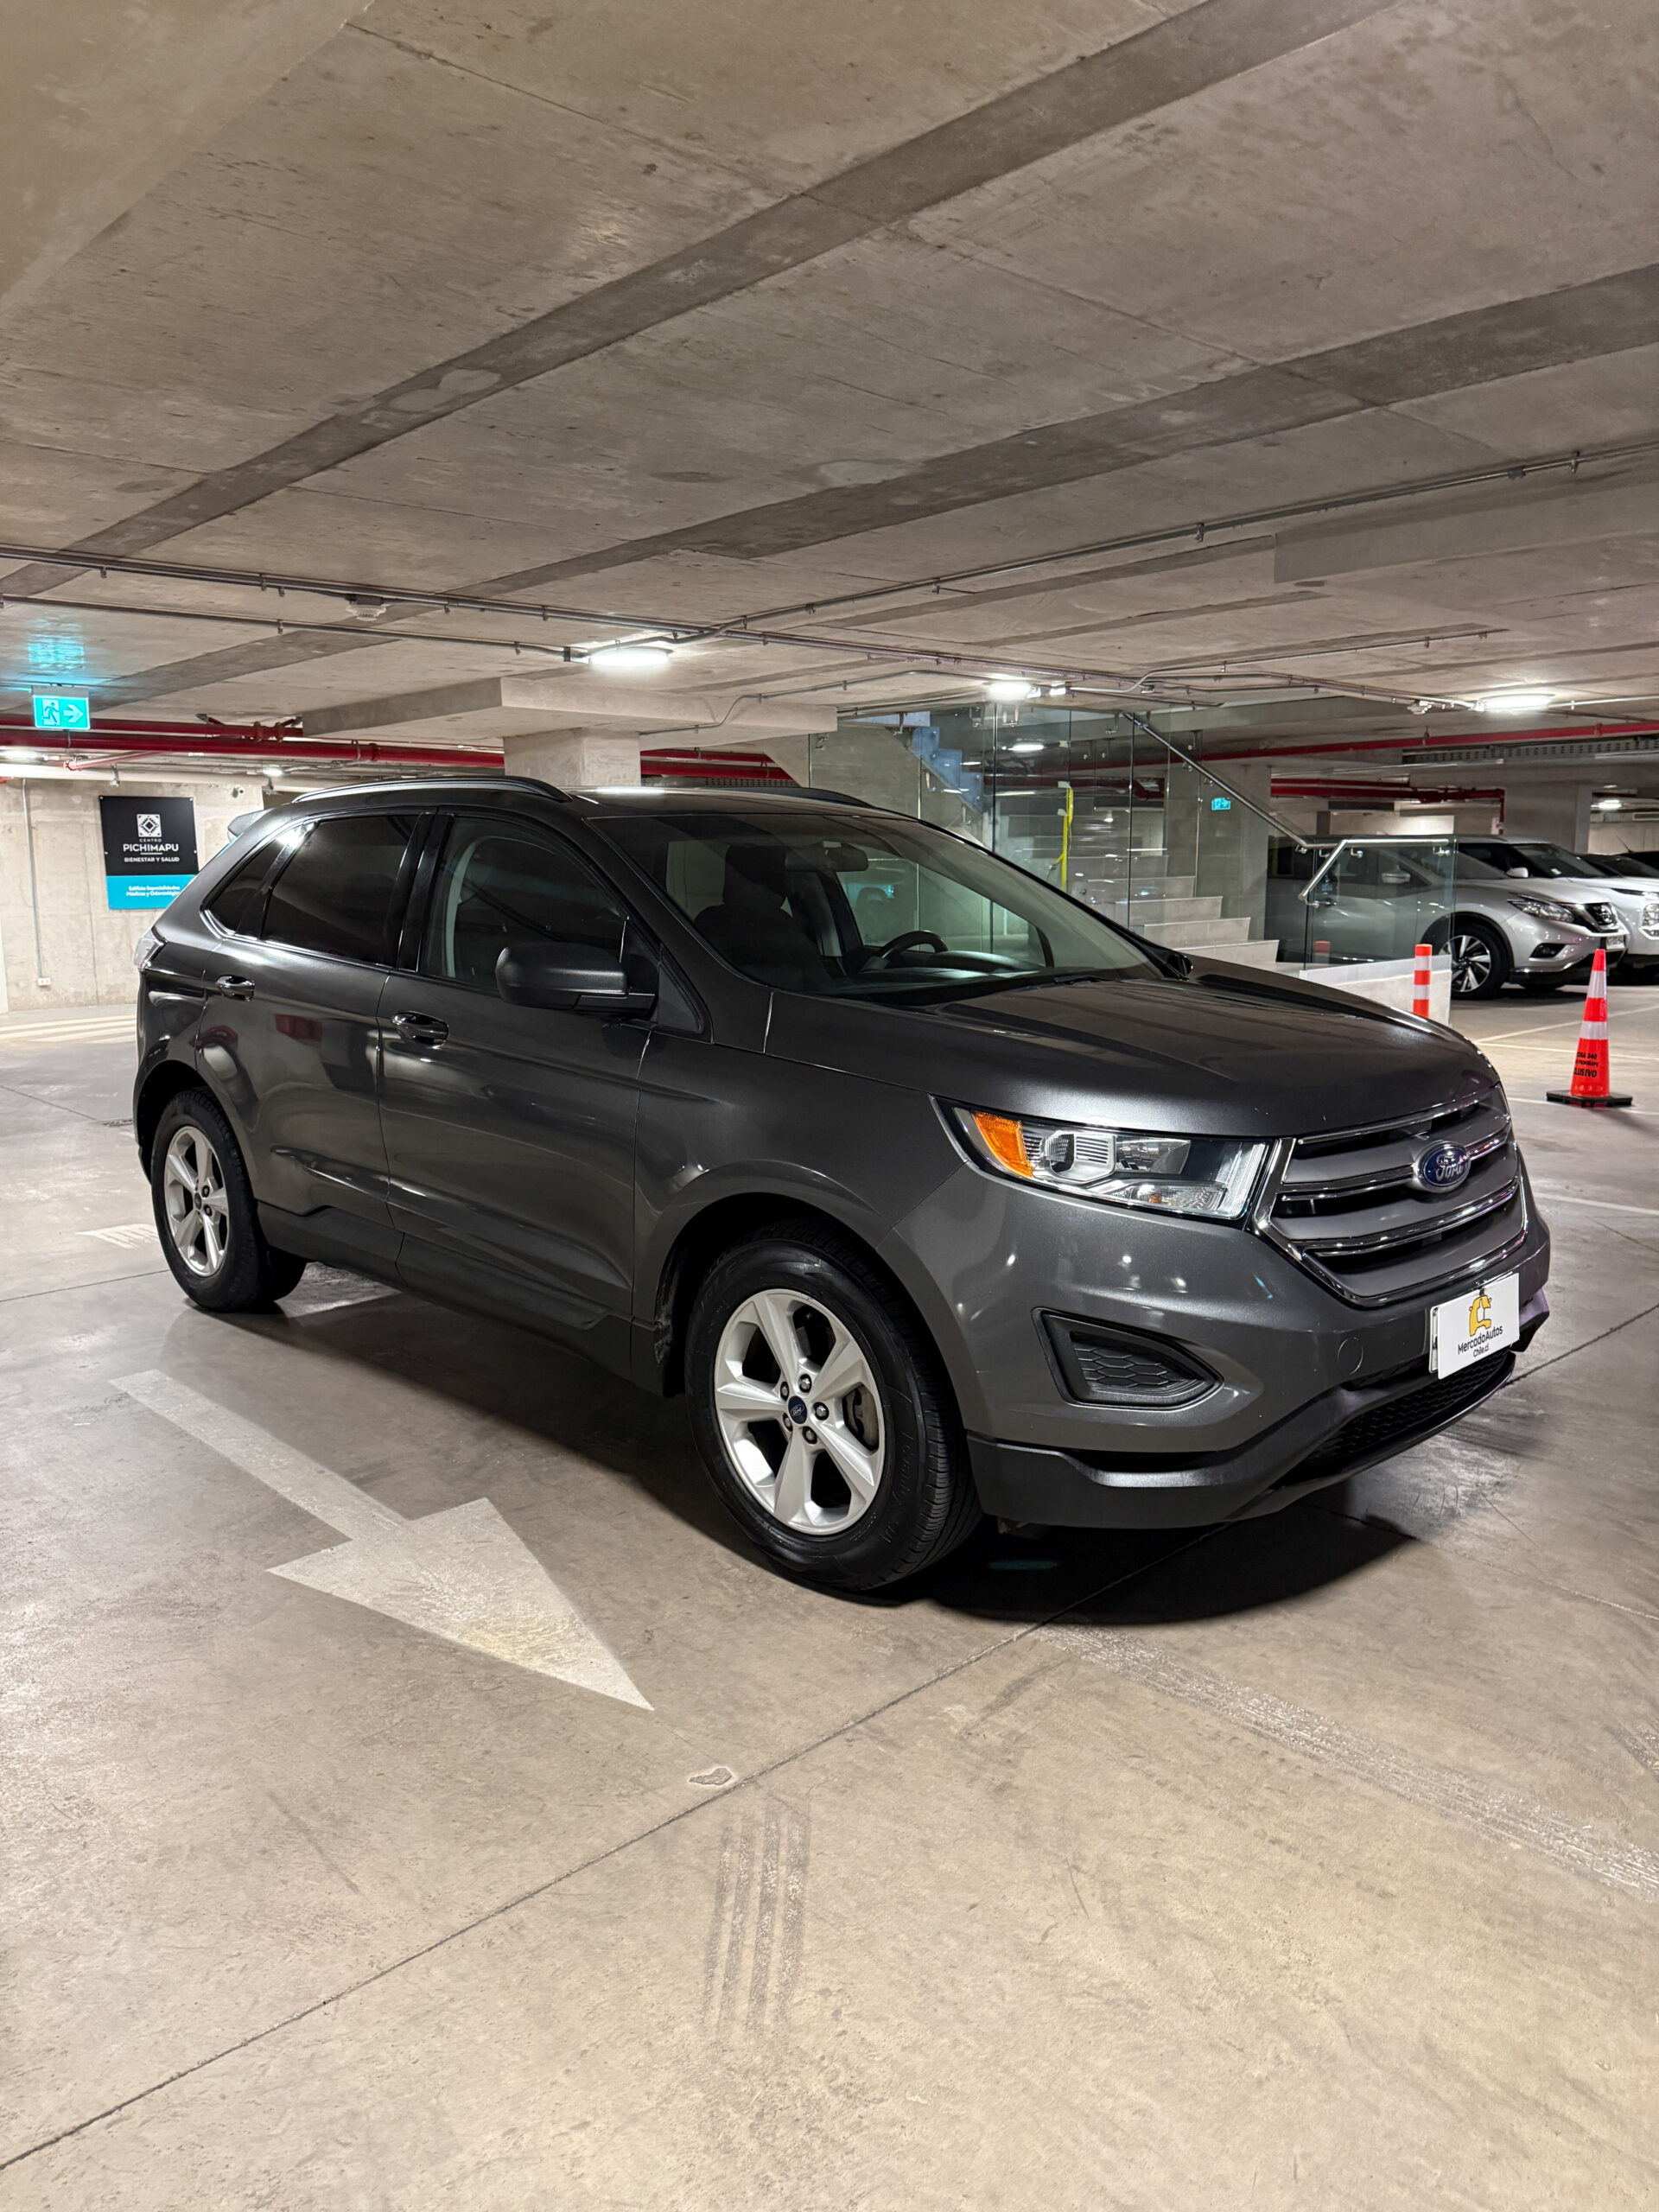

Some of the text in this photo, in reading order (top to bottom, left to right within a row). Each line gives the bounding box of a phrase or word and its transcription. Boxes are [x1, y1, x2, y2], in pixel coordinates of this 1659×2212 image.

[123, 843, 179, 852] PICHIMAPU
[1573, 1068, 1598, 1077] LUSIVO
[1435, 1154, 1464, 1181] Ford
[1458, 1325, 1503, 1355] MercadoAutos
[791, 1406, 803, 1415] Ford
